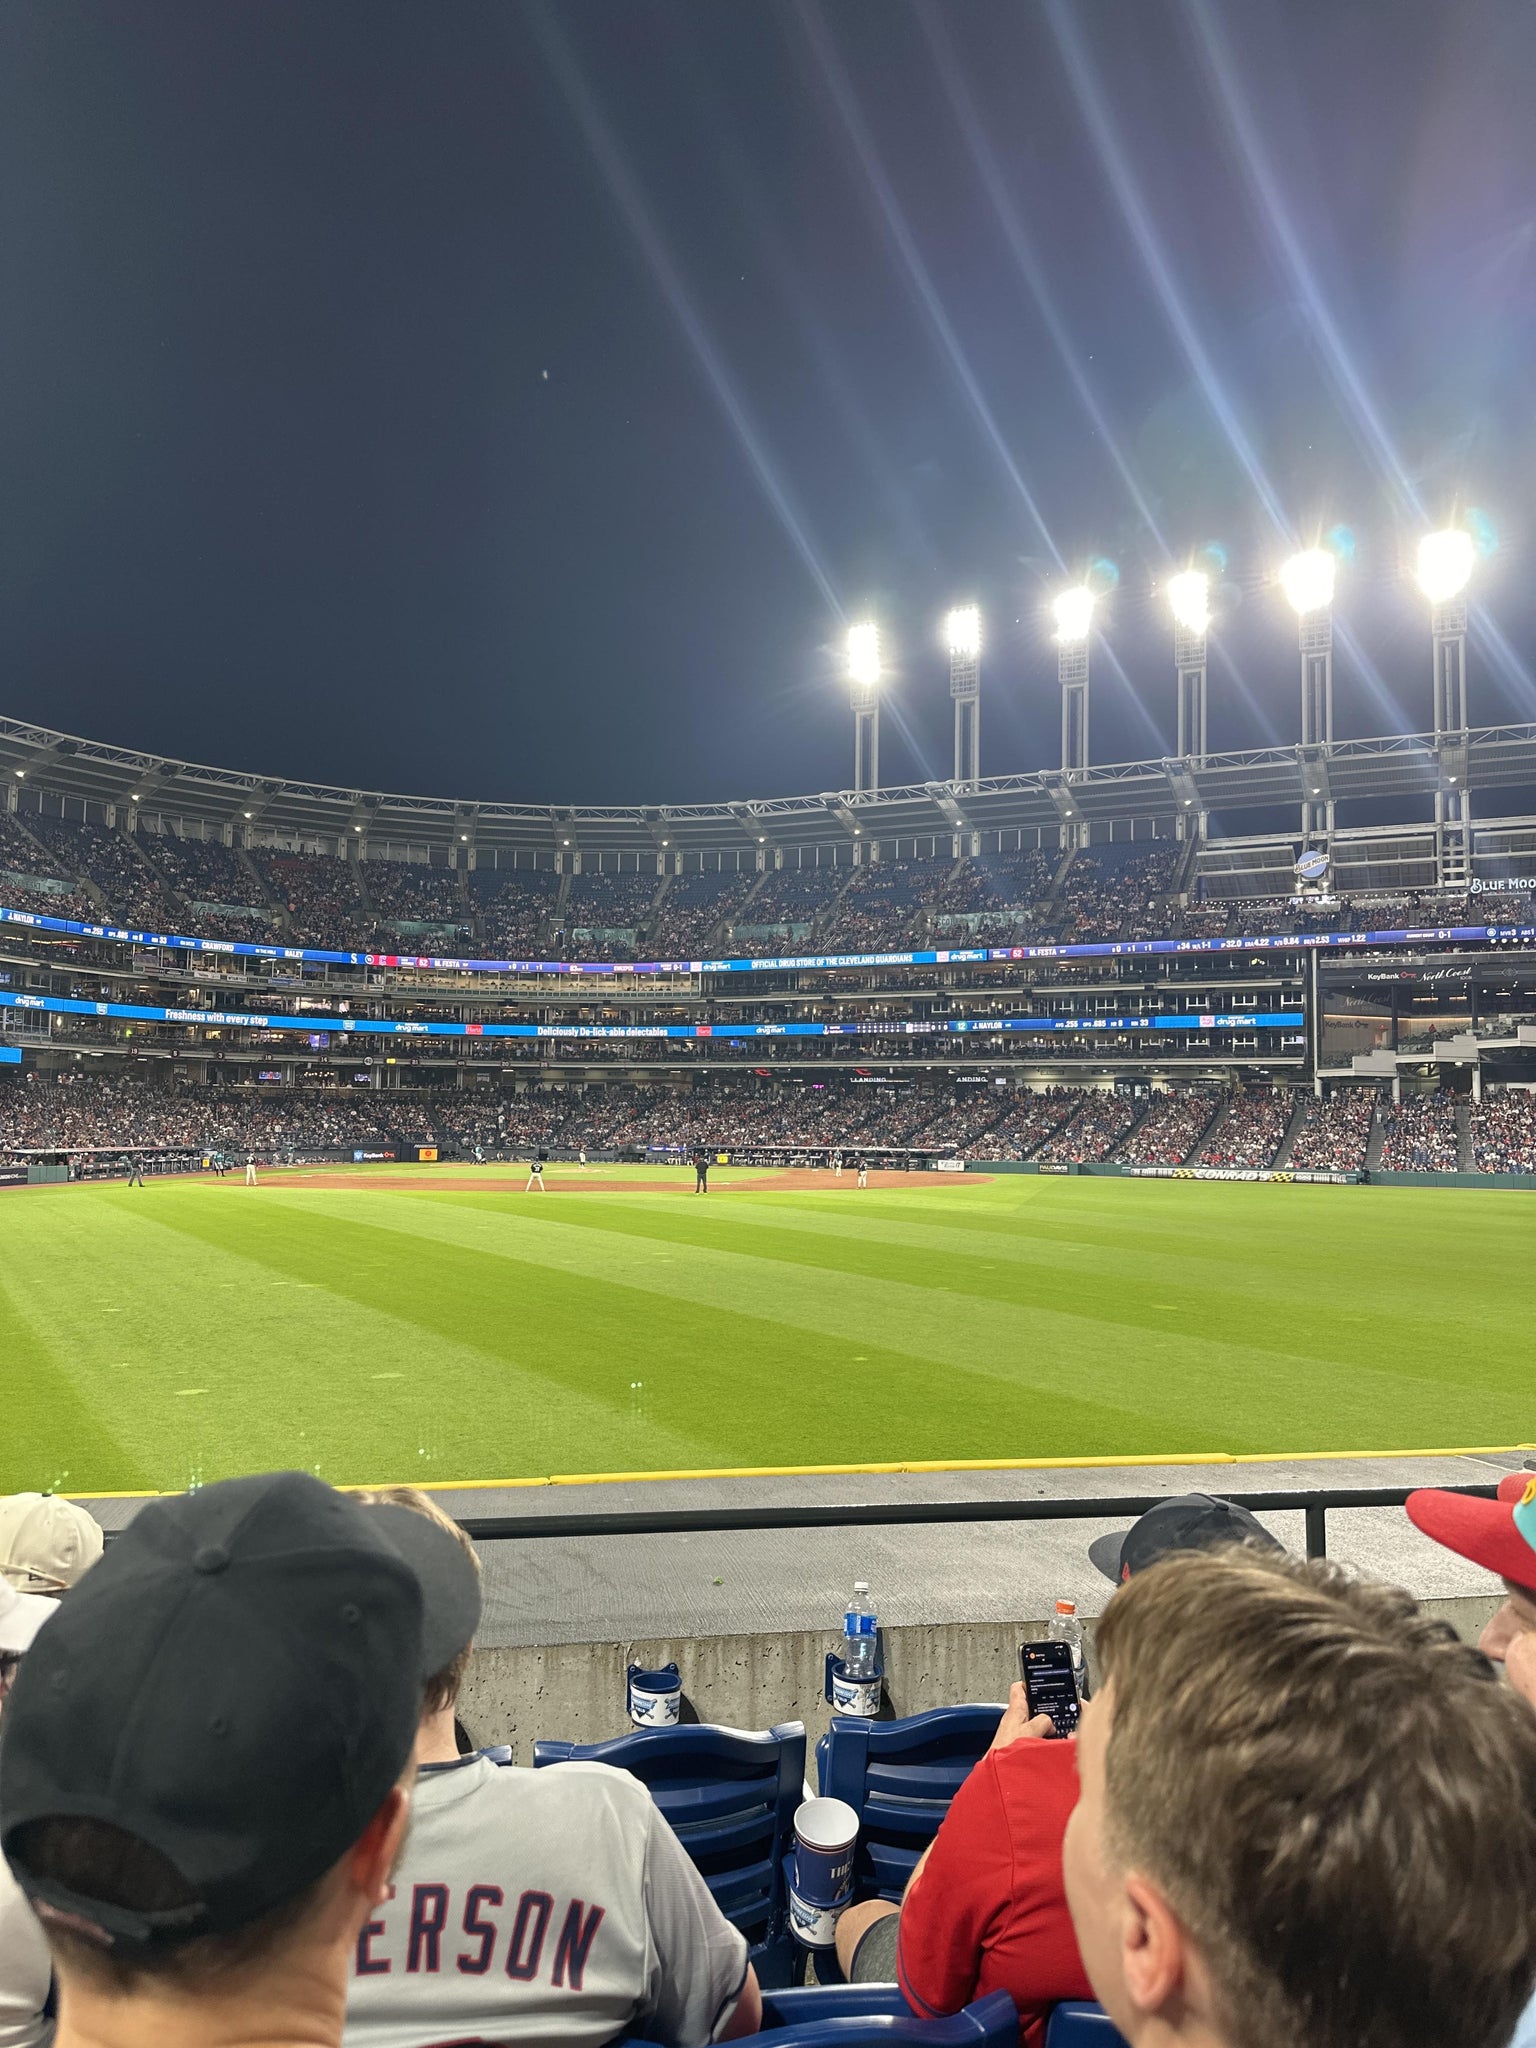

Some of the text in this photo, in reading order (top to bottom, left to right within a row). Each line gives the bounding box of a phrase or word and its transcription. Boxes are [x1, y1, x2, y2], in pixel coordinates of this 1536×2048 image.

[1470, 878, 1505, 893] BLUE
[1254, 938, 1270, 946] 4.22
[1283, 937, 1299, 945] 9.84
[1315, 936, 1330, 944] 2.53
[1351, 934, 1366, 942] 1.22
[202, 941, 234, 952] CRAWFORD
[1226, 939, 1241, 948] 32.0
[1012, 949, 1022, 957] 52
[1037, 948, 1057, 956] FESTA
[351, 953, 358, 964] S
[950, 953, 967, 961] drug
[442, 960, 460, 968] FESTA
[751, 960, 778, 969] OFFICIAL
[779, 959, 796, 968] DRUG
[796, 959, 816, 967] STORE
[826, 957, 838, 965] THE
[838, 955, 875, 965] CLEVELAND
[876, 954, 913, 964] GUARDIANS
[703, 963, 717, 971] drug
[1367, 973, 1400, 981] KeyBank
[1417, 968, 1445, 982] North
[15, 996, 45, 1007] drug mart
[165, 1009, 268, 1026] Freshness with every step
[1216, 1017, 1236, 1026] drug
[1236, 1017, 1256, 1025] mart
[395, 1024, 412, 1032] drug
[412, 1024, 429, 1032] mart
[1064, 1020, 1078, 1028] .255
[1324, 1020, 1354, 1029] KeyBank
[537, 1026, 668, 1037] Deliciously De-lick-able delectables
[756, 1027, 771, 1035] drug
[1195, 1168, 1270, 1181] CONRAD'S
[355, 1883, 606, 1992] ERSON
